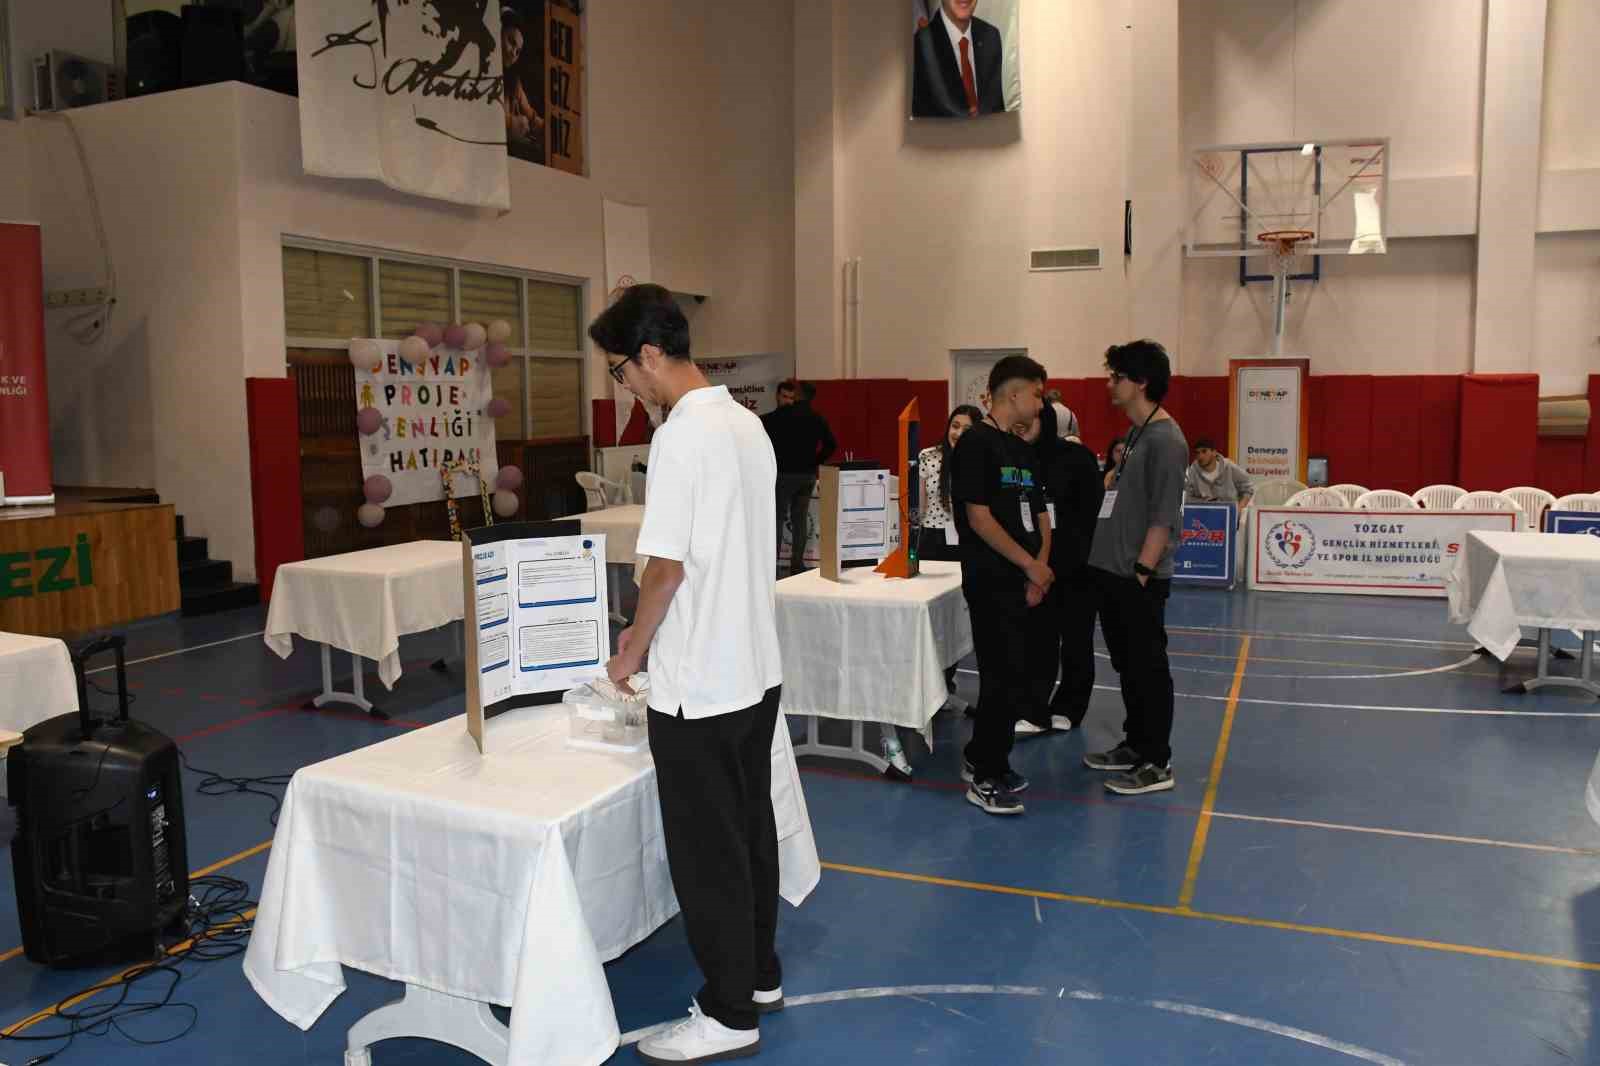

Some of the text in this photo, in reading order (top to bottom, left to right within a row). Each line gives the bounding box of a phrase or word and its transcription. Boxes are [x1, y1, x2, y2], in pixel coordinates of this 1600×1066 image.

[385, 384, 459, 406] PROJE
[1353, 524, 1404, 534] YOZGAT
[1322, 538, 1366, 550] GENÇLİK
